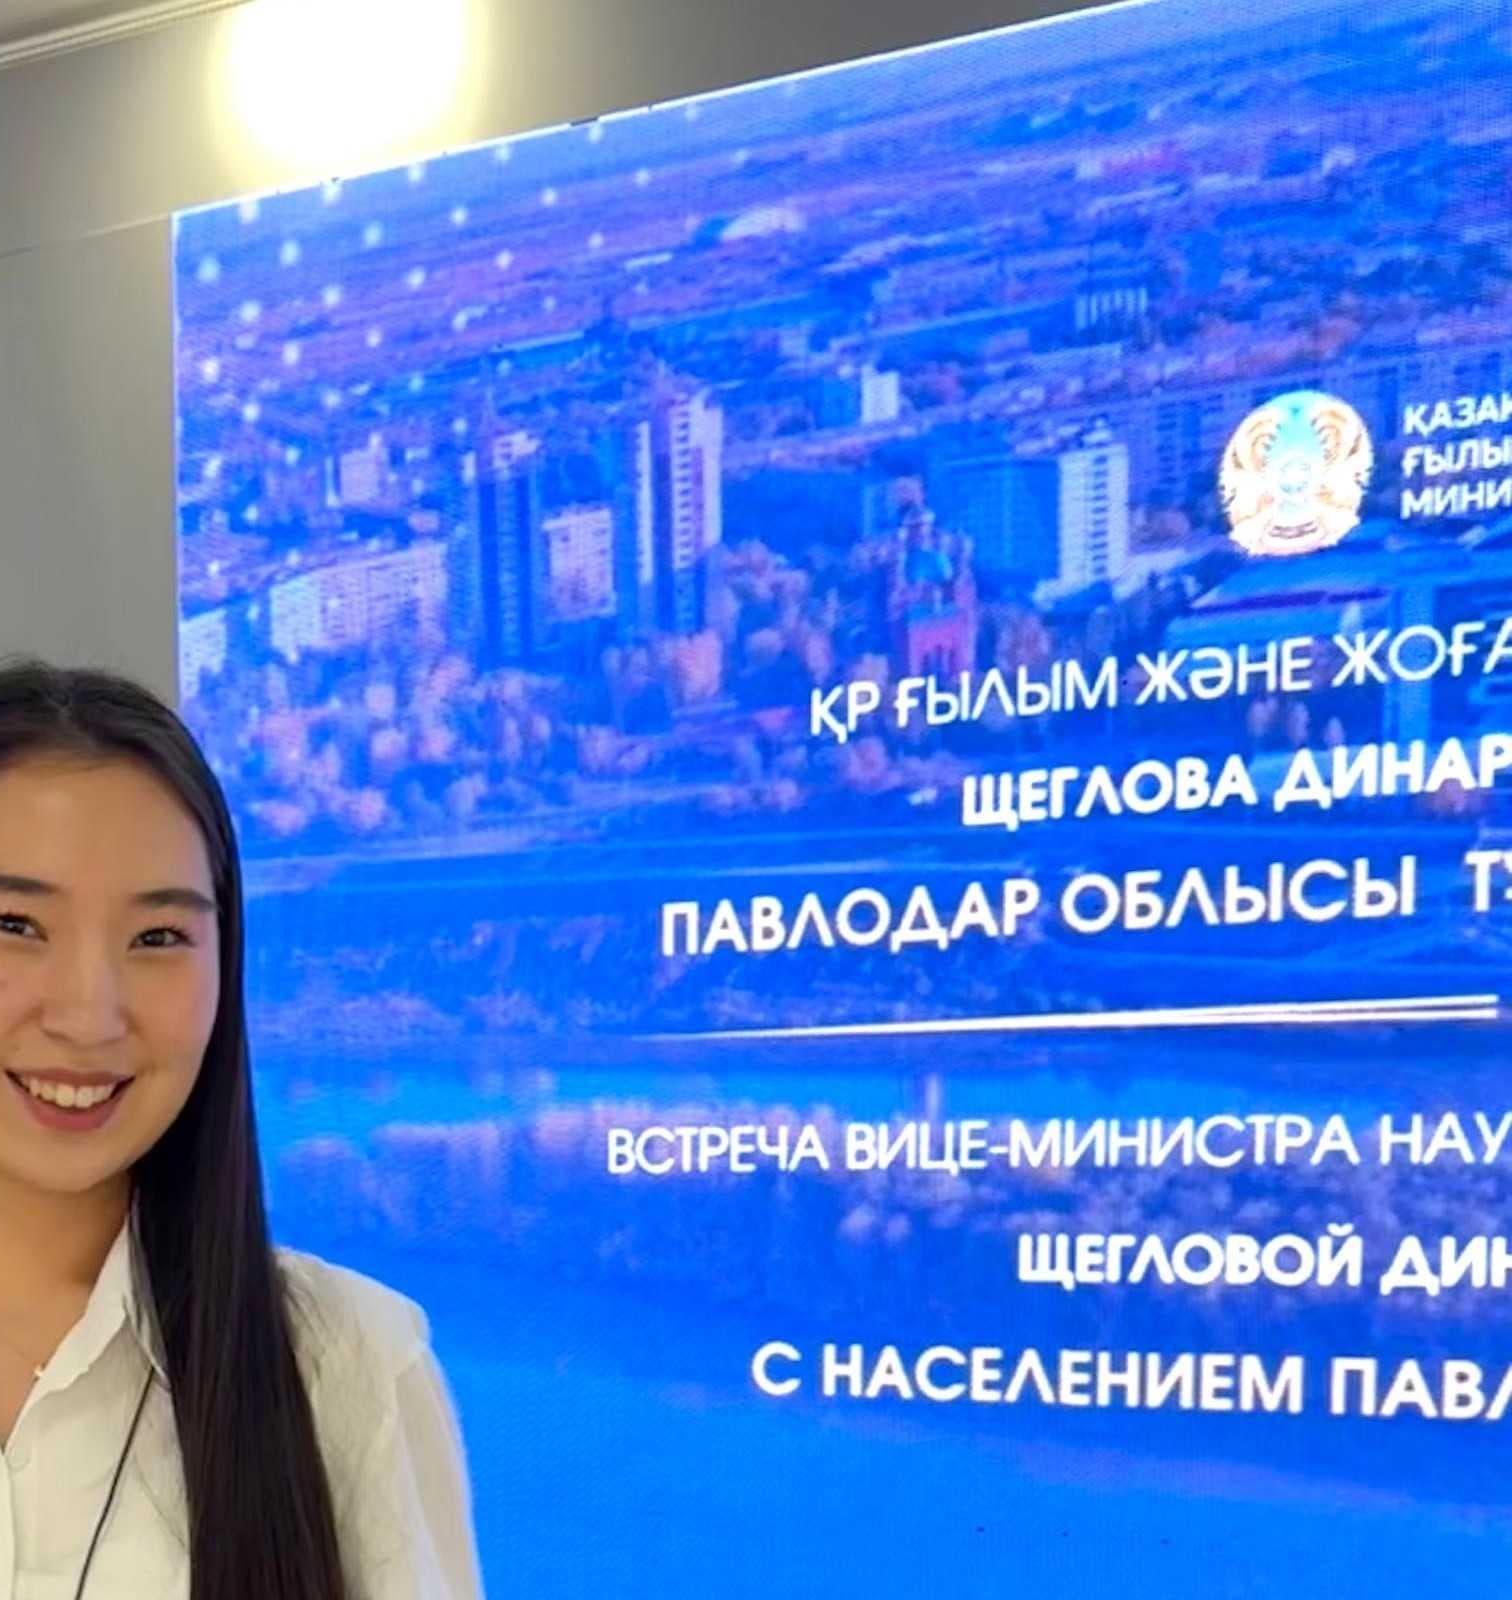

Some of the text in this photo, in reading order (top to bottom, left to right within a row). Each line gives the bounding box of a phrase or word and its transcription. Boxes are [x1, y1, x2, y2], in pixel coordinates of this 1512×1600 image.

[1400, 479, 1512, 520] МИНИ
[810, 680, 881, 744] ҚР
[893, 656, 1118, 728] ҒЫЛЫМ
[1136, 636, 1314, 706] ЖӘНЕ
[961, 733, 1512, 832] ЩЕГЛОВА ДИНАР
[661, 849, 1512, 957] ПАВЛОДАР ОБЛЫСЫ Т
[606, 1111, 1512, 1178] ВСТРЕЧА ВИЦЕ-МИНИСТРА НАУ
[1017, 1222, 1364, 1293] ЩЕГЛОВОЙ
[751, 1341, 801, 1397] С
[822, 1343, 1304, 1414] НАСЕЛЕНИЕМ
